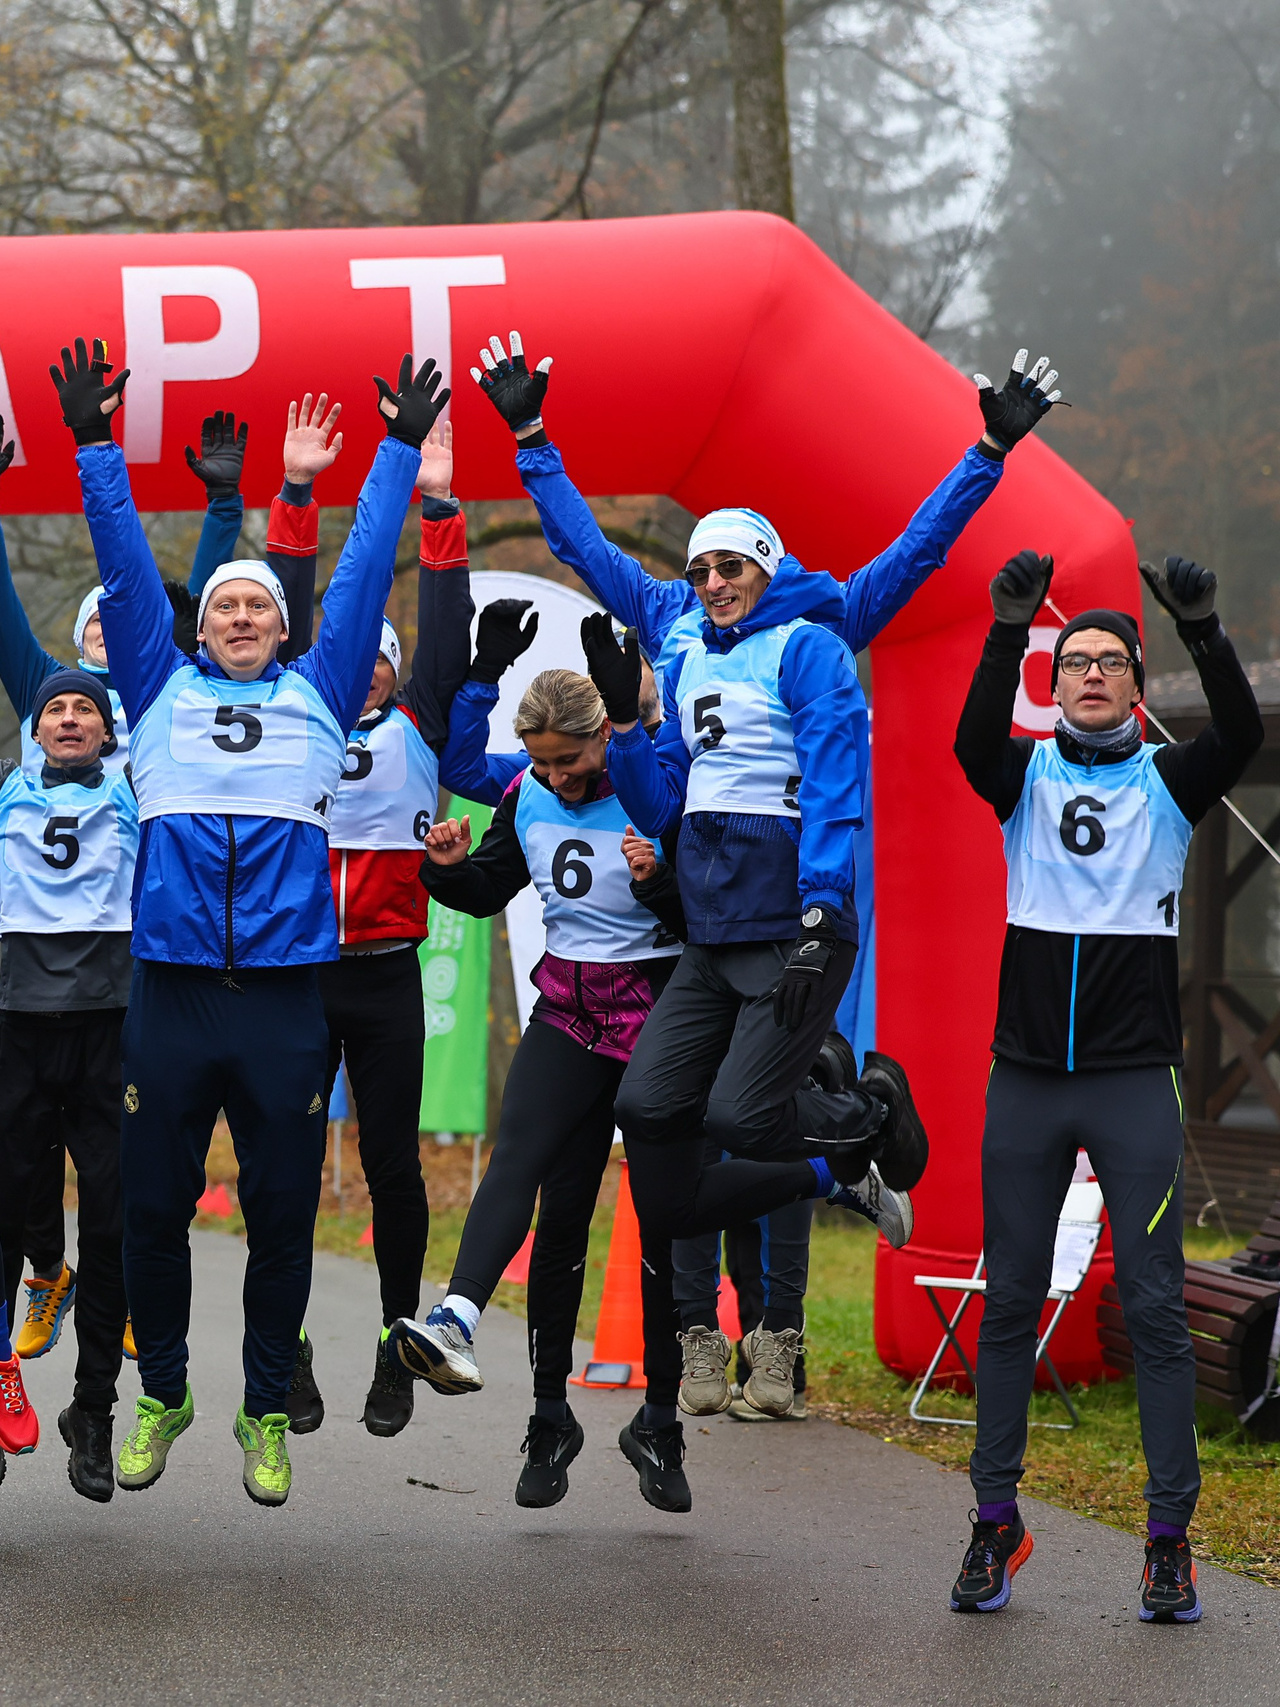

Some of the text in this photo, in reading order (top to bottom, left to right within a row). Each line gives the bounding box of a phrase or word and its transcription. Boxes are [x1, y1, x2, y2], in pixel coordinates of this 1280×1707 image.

[212, 703, 263, 753] 5
[694, 693, 727, 750] 5
[41, 816, 80, 870] 5
[412, 810, 430, 842] 6
[1059, 795, 1107, 857] 6
[551, 839, 595, 899] 6
[1157, 890, 1176, 928] 1
